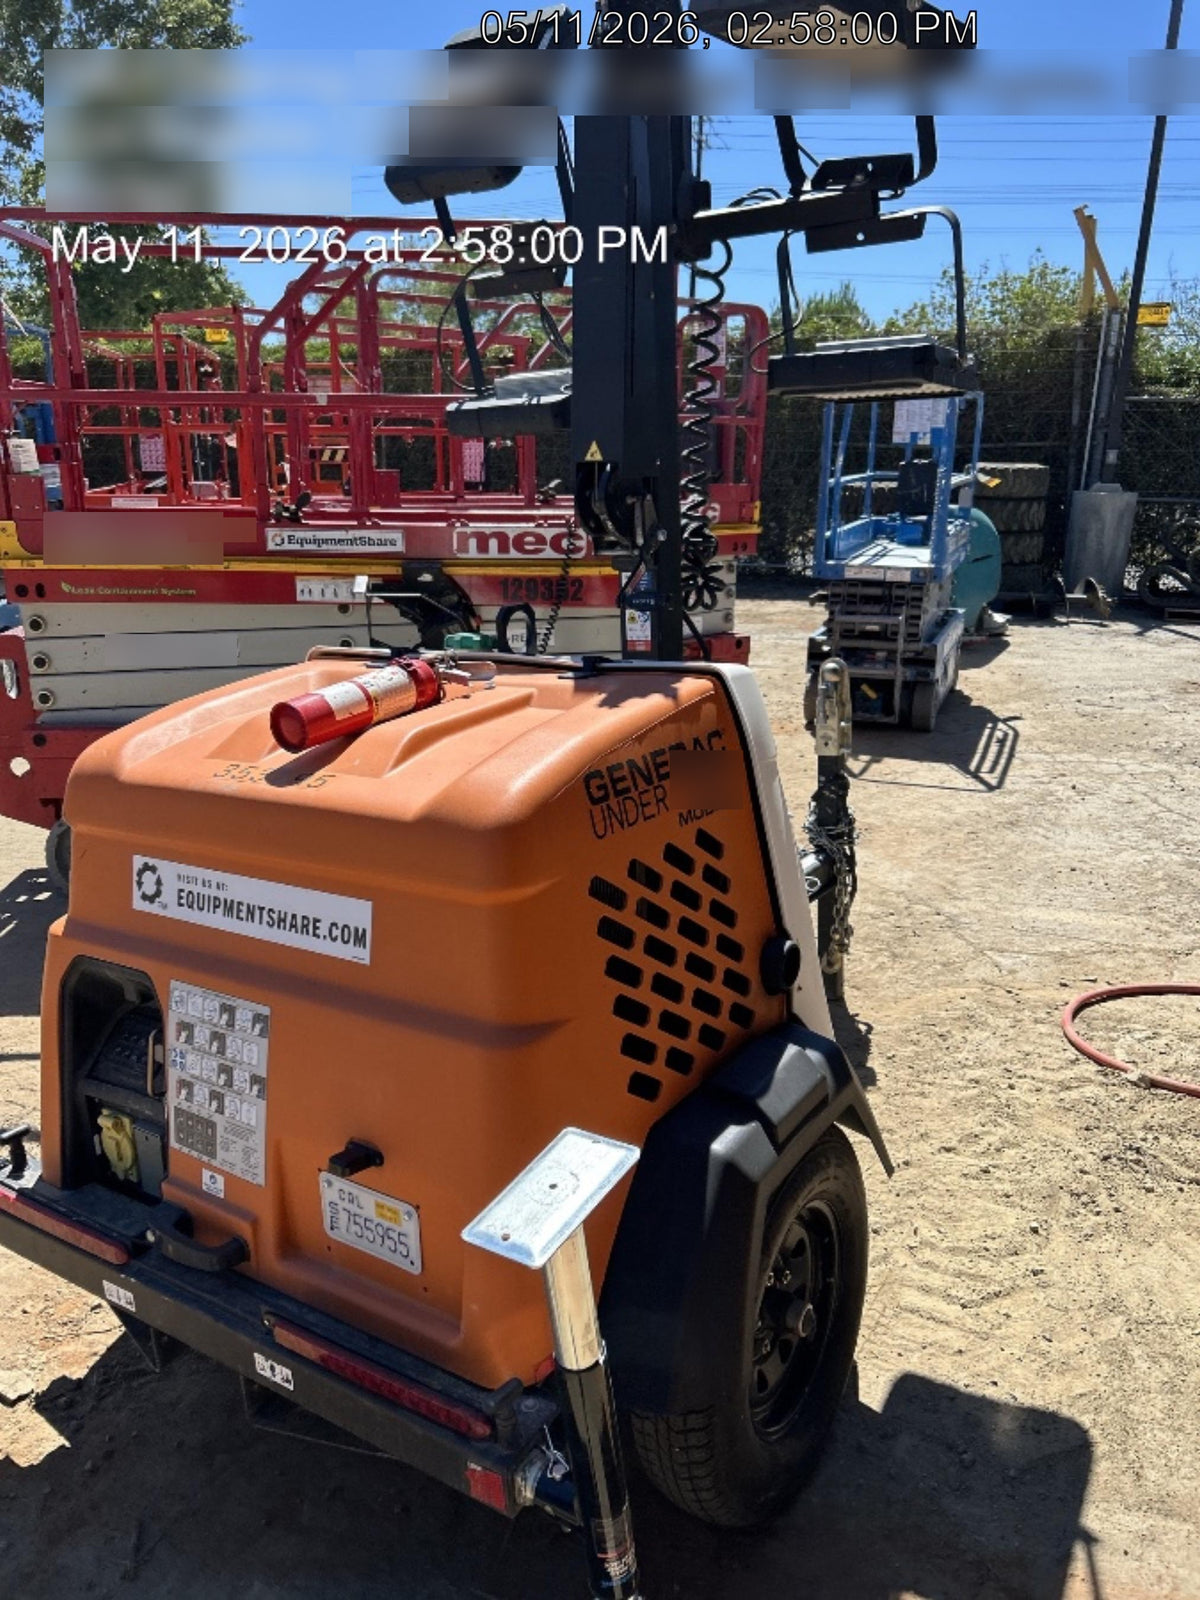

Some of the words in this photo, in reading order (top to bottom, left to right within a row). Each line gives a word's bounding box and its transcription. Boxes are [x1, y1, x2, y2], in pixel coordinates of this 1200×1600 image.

[287, 534, 397, 547] EquipmentShare
[456, 531, 585, 555] mec
[589, 784, 670, 840] UNDER
[177, 888, 367, 949] EQUIPMENTSHARE.COM
[342, 1207, 410, 1259] 755955
